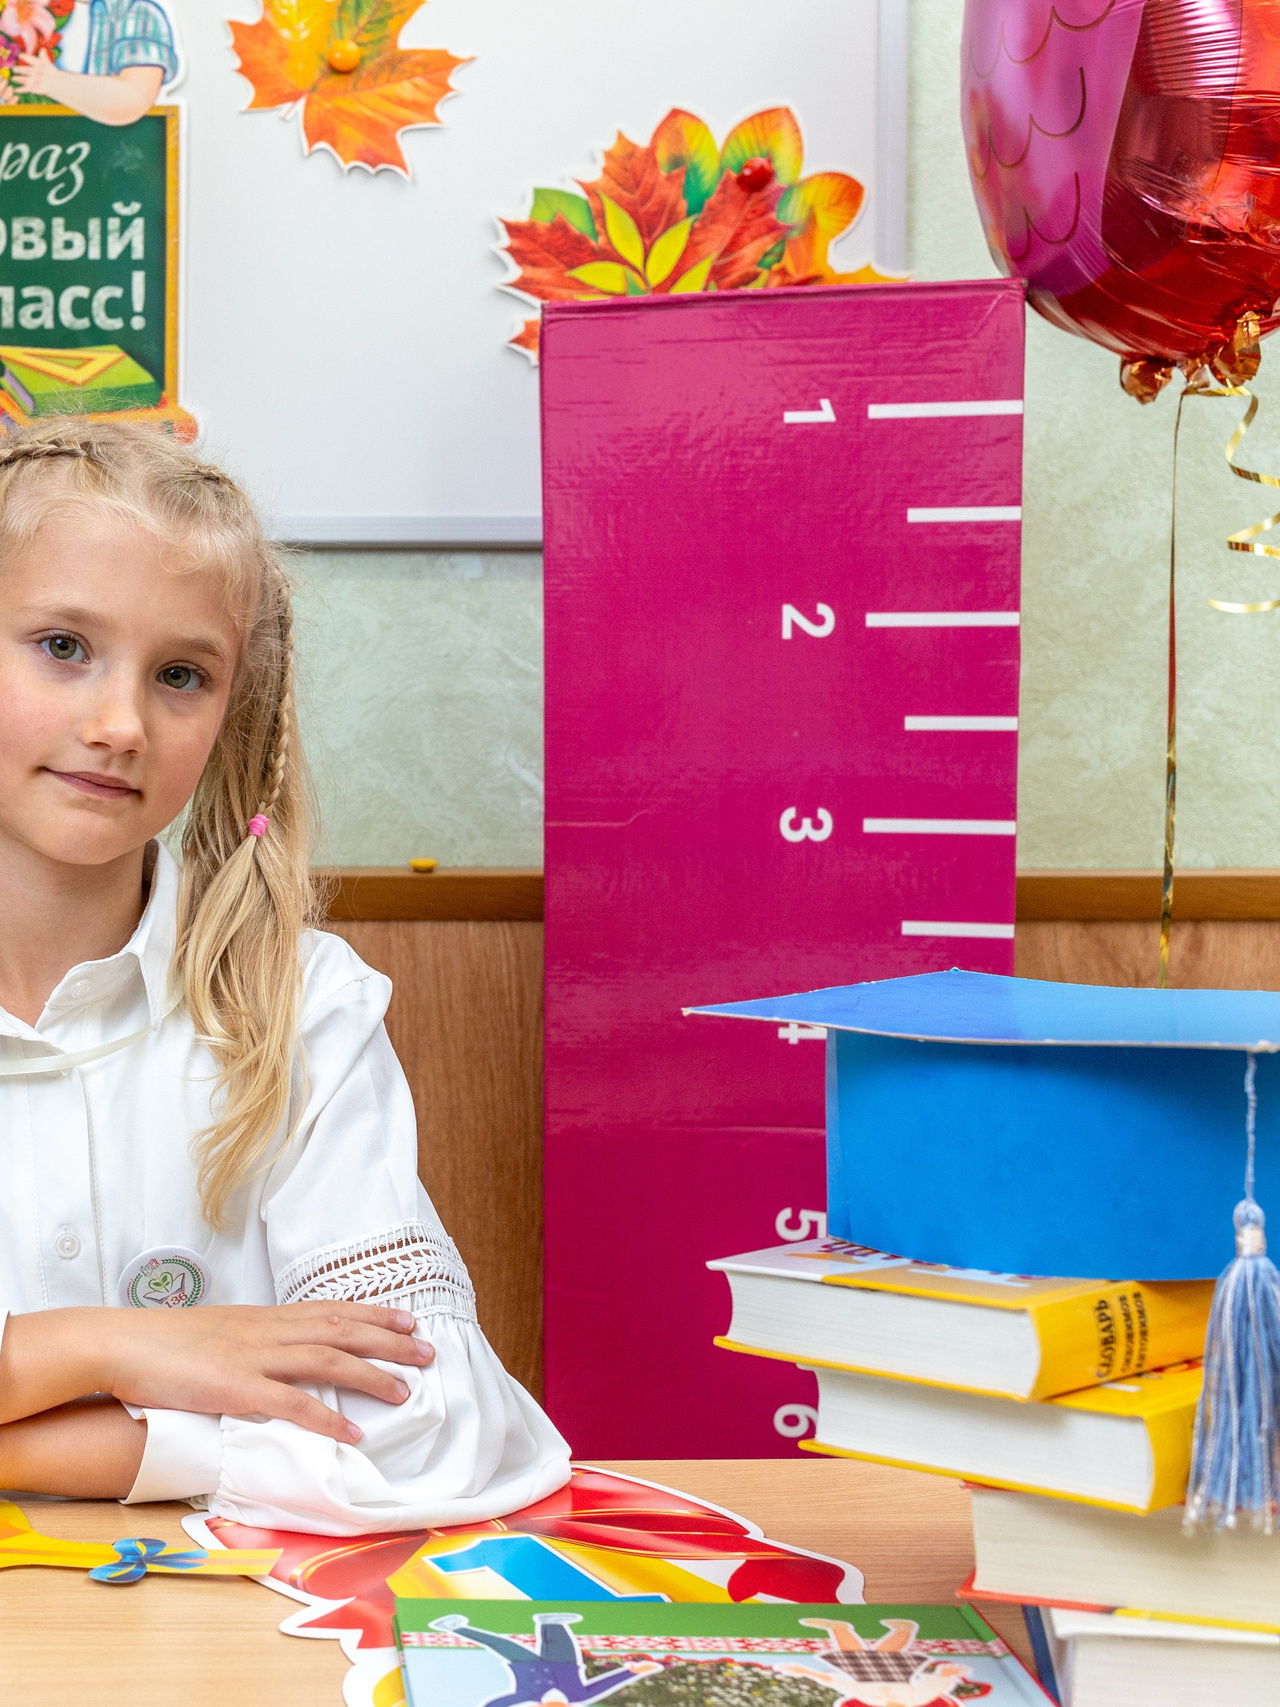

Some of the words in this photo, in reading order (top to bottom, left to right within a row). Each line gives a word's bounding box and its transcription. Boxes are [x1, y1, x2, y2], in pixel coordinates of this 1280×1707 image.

[783, 399, 837, 423] 1
[782, 603, 835, 640] 2
[779, 806, 833, 842] 3
[775, 1207, 827, 1241] 5
[164, 1291, 189, 1309] 136
[773, 1403, 819, 1437] 6
